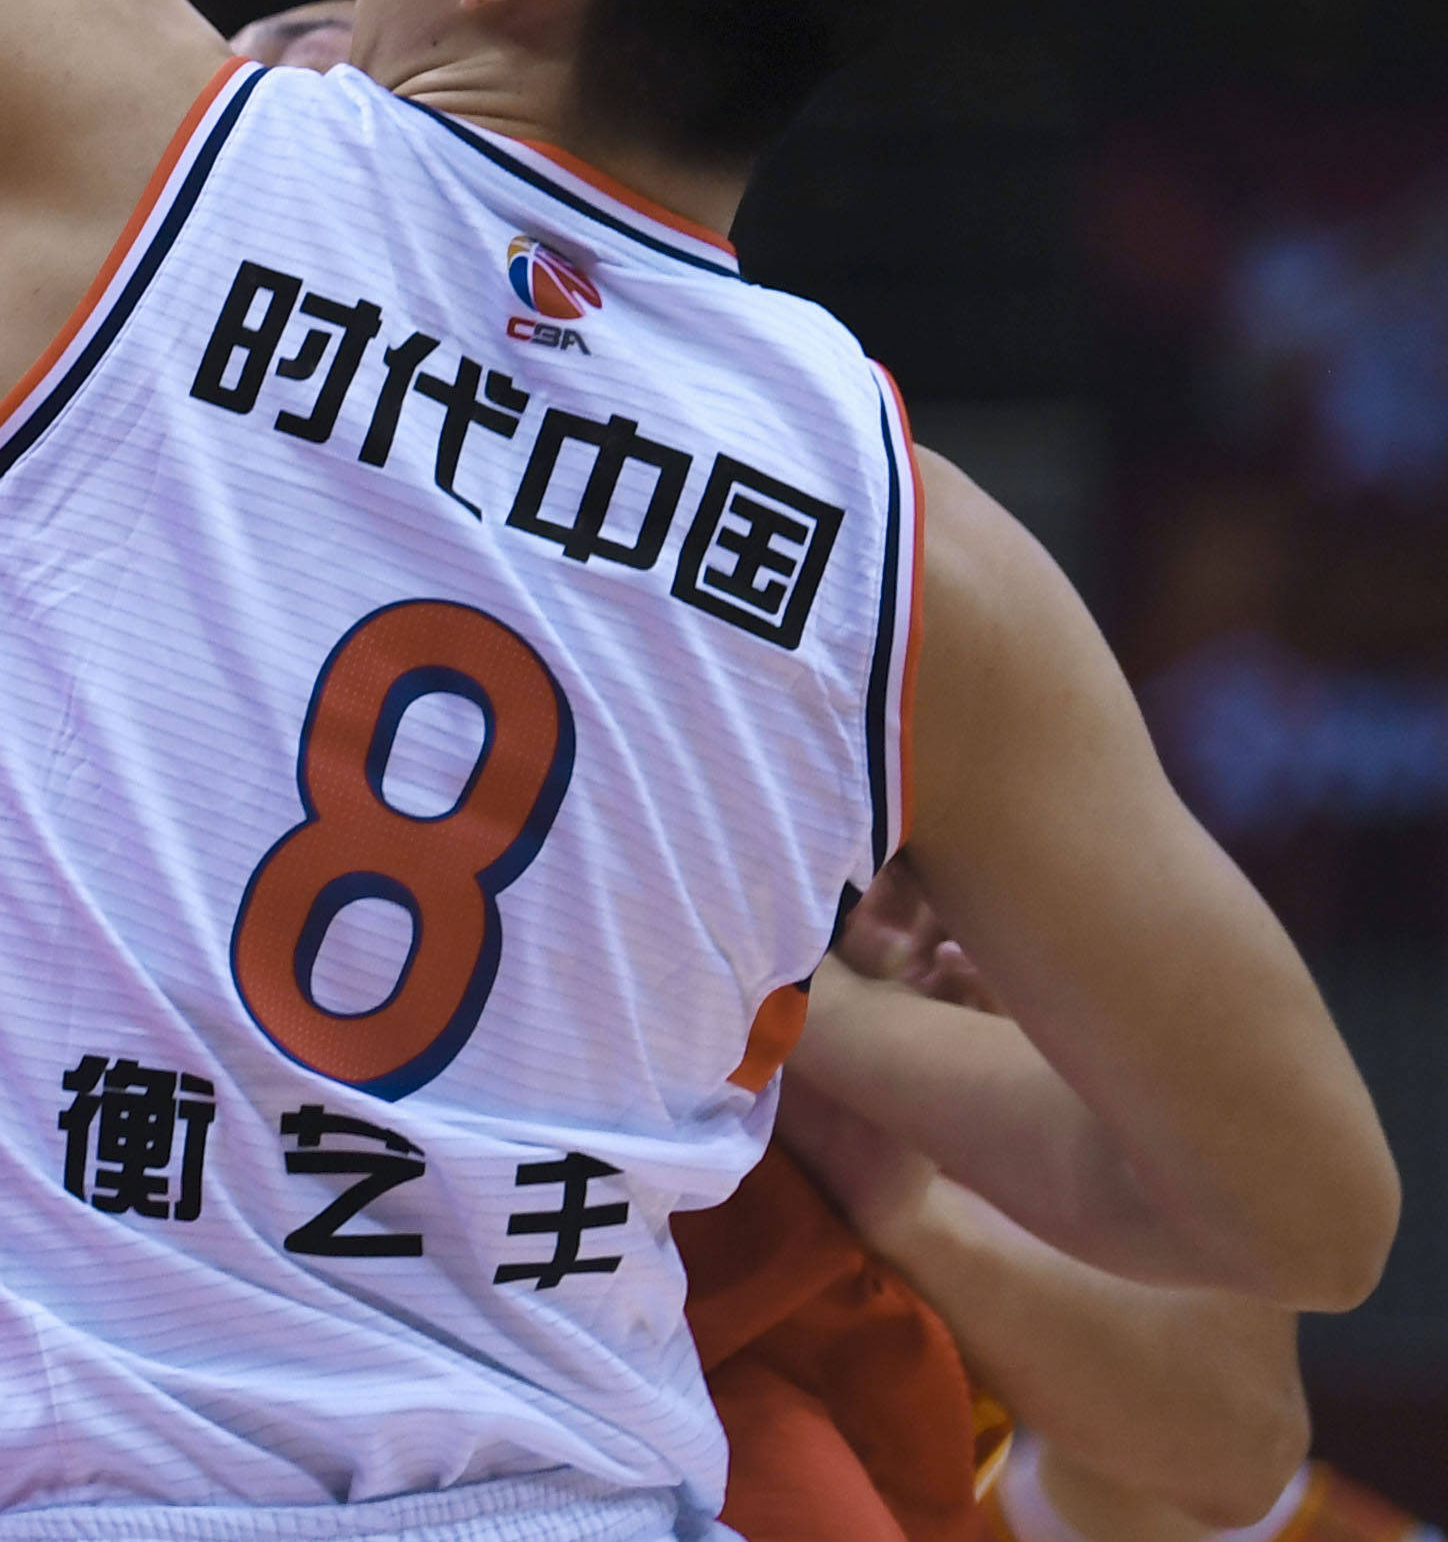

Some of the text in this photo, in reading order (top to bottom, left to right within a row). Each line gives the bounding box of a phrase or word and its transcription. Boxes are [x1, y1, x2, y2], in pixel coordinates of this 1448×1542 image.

[190, 259, 845, 651] 时代中国
[506, 316, 592, 356] CBA
[230, 597, 578, 1103] 8
